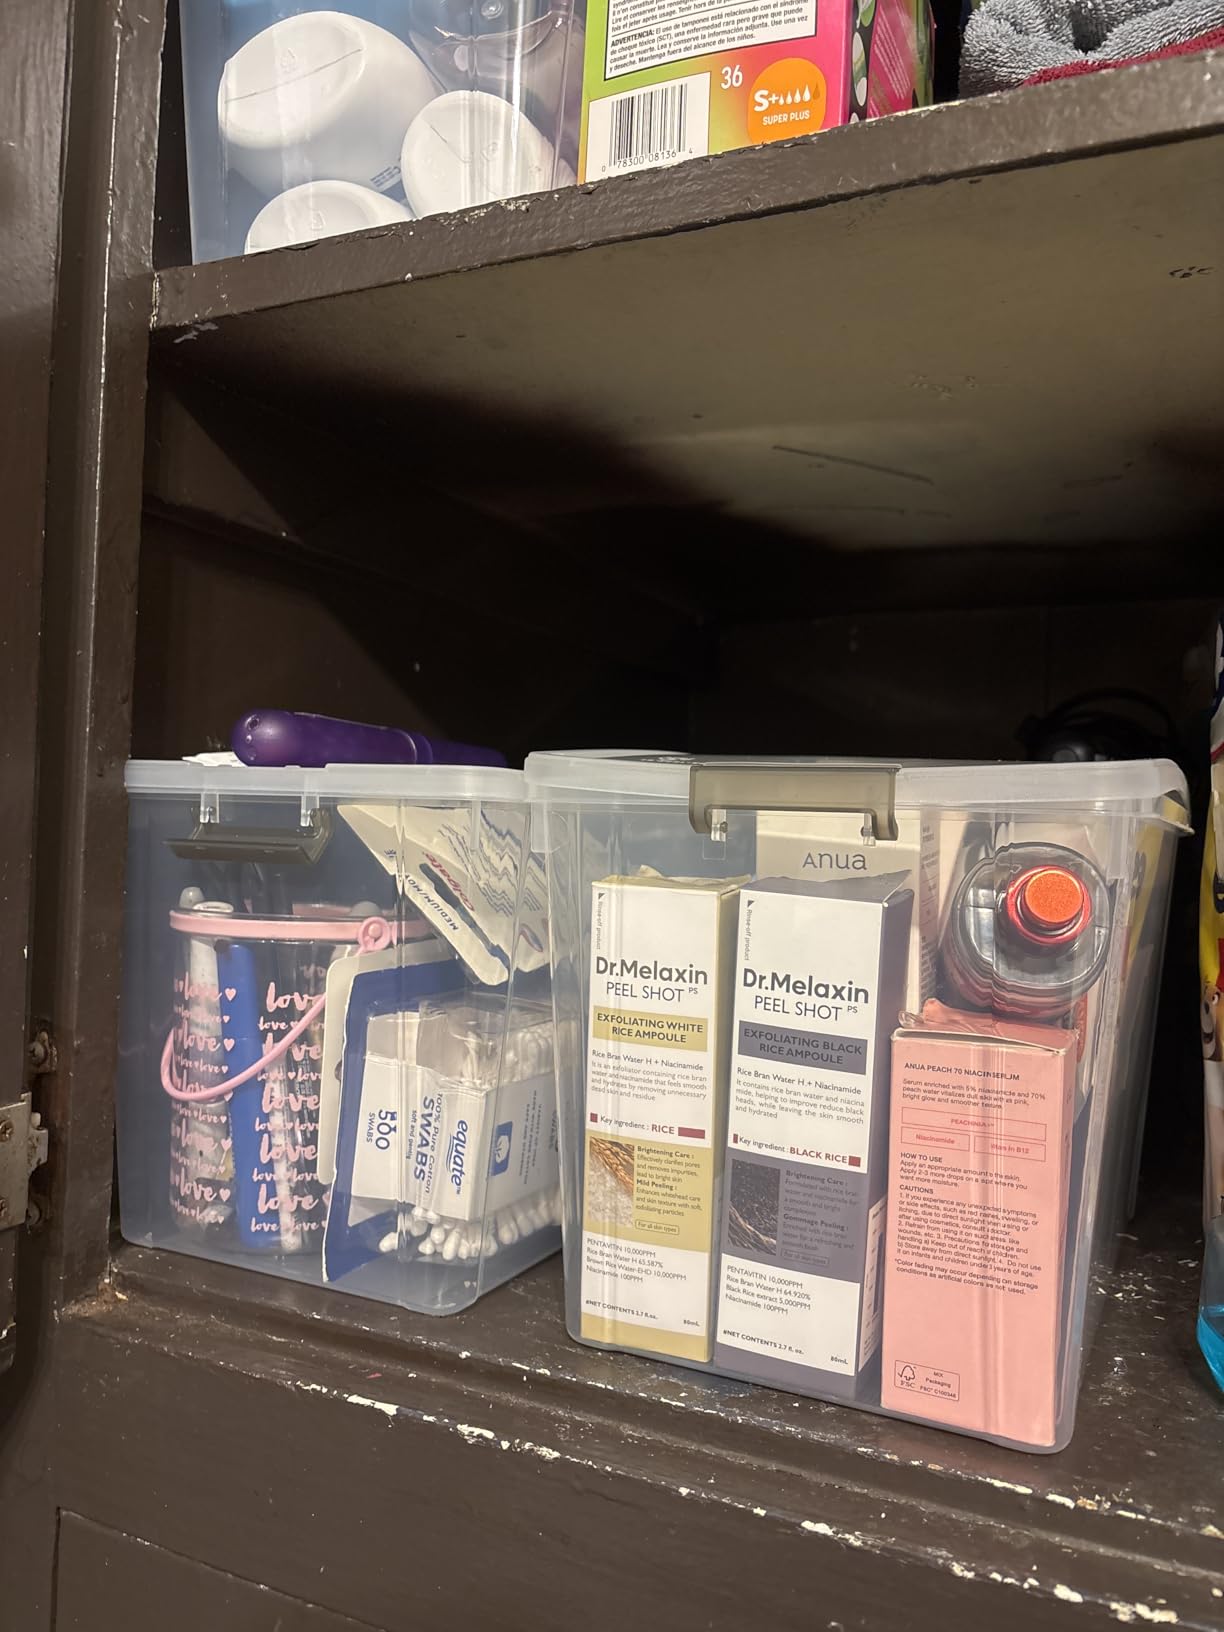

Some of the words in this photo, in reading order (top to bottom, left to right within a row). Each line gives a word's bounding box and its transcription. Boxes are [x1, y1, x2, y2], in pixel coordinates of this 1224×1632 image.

[611, 29, 654, 47] ADVERTENCIA:
[710, 13, 723, 21] está
[724, 6, 759, 18] relacionado
[686, 22, 721, 35] enfermedad
[736, 17, 750, 26] pero
[752, 13, 769, 23] grave
[783, 7, 803, 17] puede
[708, 27, 743, 38] información
[745, 22, 769, 31] adjunta.
[638, 52, 666, 63] Mantenga
[694, 40, 716, 50] alcance
[720, 64, 743, 89] 36
[762, 114, 788, 126] SUPER
[790, 110, 810, 121] PLUS
[617, 155, 645, 168] 78300
[648, 151, 677, 162] 08136
[423, 852, 474, 911] Colgate
[404, 874, 459, 930] MEDIUM/MOY
[596, 957, 707, 984] Dr.Melaxin
[606, 982, 637, 998] PEEL
[642, 986, 684, 1002] SHOT
[744, 969, 868, 1003] Dr.Melaxin
[755, 995, 790, 1014] PEEL
[795, 1002, 842, 1021] SHOT
[847, 1005, 858, 1014] PS
[258, 1016, 288, 1032] love
[598, 1013, 664, 1029] EXFOLIATING
[666, 1021, 703, 1033] WHITE
[612, 1026, 633, 1037] RICE
[635, 1030, 686, 1043] AMPOULE
[183, 1020, 220, 1051] love
[744, 1029, 819, 1048] EXFOLIATING
[823, 1041, 862, 1055] BLACK
[592, 1049, 605, 1058] Rice
[622, 1054, 644, 1063] Water
[661, 1060, 703, 1070] Niacinamide
[760, 1043, 784, 1055] RICE
[786, 1048, 843, 1064] AMPOULE
[642, 1070, 676, 1080] containing
[904, 1062, 926, 1070] ANUA
[927, 1065, 952, 1073] PEACH
[737, 1067, 752, 1076] Rice
[754, 1070, 770, 1080] Bran
[772, 1074, 795, 1084] Water
[814, 1081, 861, 1095] Niacinamide
[637, 1086, 666, 1096] removing
[667, 1090, 707, 1100] unnecessary
[742, 1081, 769, 1091] contains
[785, 1088, 801, 1096] bran
[840, 1098, 865, 1107] niacina
[755, 1092, 779, 1103] helping
[789, 1098, 818, 1108] improve
[819, 1104, 844, 1112] reduce
[845, 1107, 864, 1116] black
[902, 1092, 920, 1100] bright
[434, 1094, 443, 1123] 100%
[736, 1096, 756, 1106] heads,
[779, 1104, 802, 1116] leaving
[836, 1115, 864, 1124] smooth
[748, 1107, 778, 1119] hydrated
[366, 1112, 375, 1143] SWABS
[376, 1109, 395, 1150] 500
[600, 1116, 612, 1125] Key
[614, 1119, 645, 1130] ingredient
[651, 1124, 674, 1134] RICE
[414, 1096, 434, 1181] SWABS
[430, 1127, 439, 1152] Pure
[739, 1136, 751, 1146] Key
[753, 1140, 785, 1152] ingredient
[790, 1147, 822, 1159] BLACK
[825, 1153, 847, 1164] RICE
[637, 1146, 673, 1158] Brightening
[425, 1155, 435, 1194] Cotton
[900, 1160, 917, 1168] Apply
[927, 1164, 962, 1173] appropriate
[180, 1167, 216, 1202] love
[651, 1181, 673, 1191] Peeling
[899, 1184, 933, 1194] CAUTIONS
[258, 1183, 319, 1214] love
[251, 1217, 280, 1232] love
[727, 1265, 767, 1281] PENTAVITIN
[769, 1276, 803, 1289] 10,000PPM
[896, 1267, 928, 1276] conditions
[914, 1262, 934, 1272] fading
[726, 1274, 739, 1283] Rice
[740, 1278, 754, 1287] Bran
[755, 1282, 775, 1292] Water
[784, 1289, 811, 1300] 64.920%
[726, 1284, 741, 1294] Black
[742, 1288, 755, 1297] Rice
[756, 1294, 778, 1303] extract
[779, 1297, 811, 1310] 5,000PPM
[602, 1303, 634, 1315] CONTENTS
[725, 1294, 761, 1308] Niacinamide
[764, 1304, 788, 1315] 100PPM
[741, 1334, 777, 1348] CONTENTS
